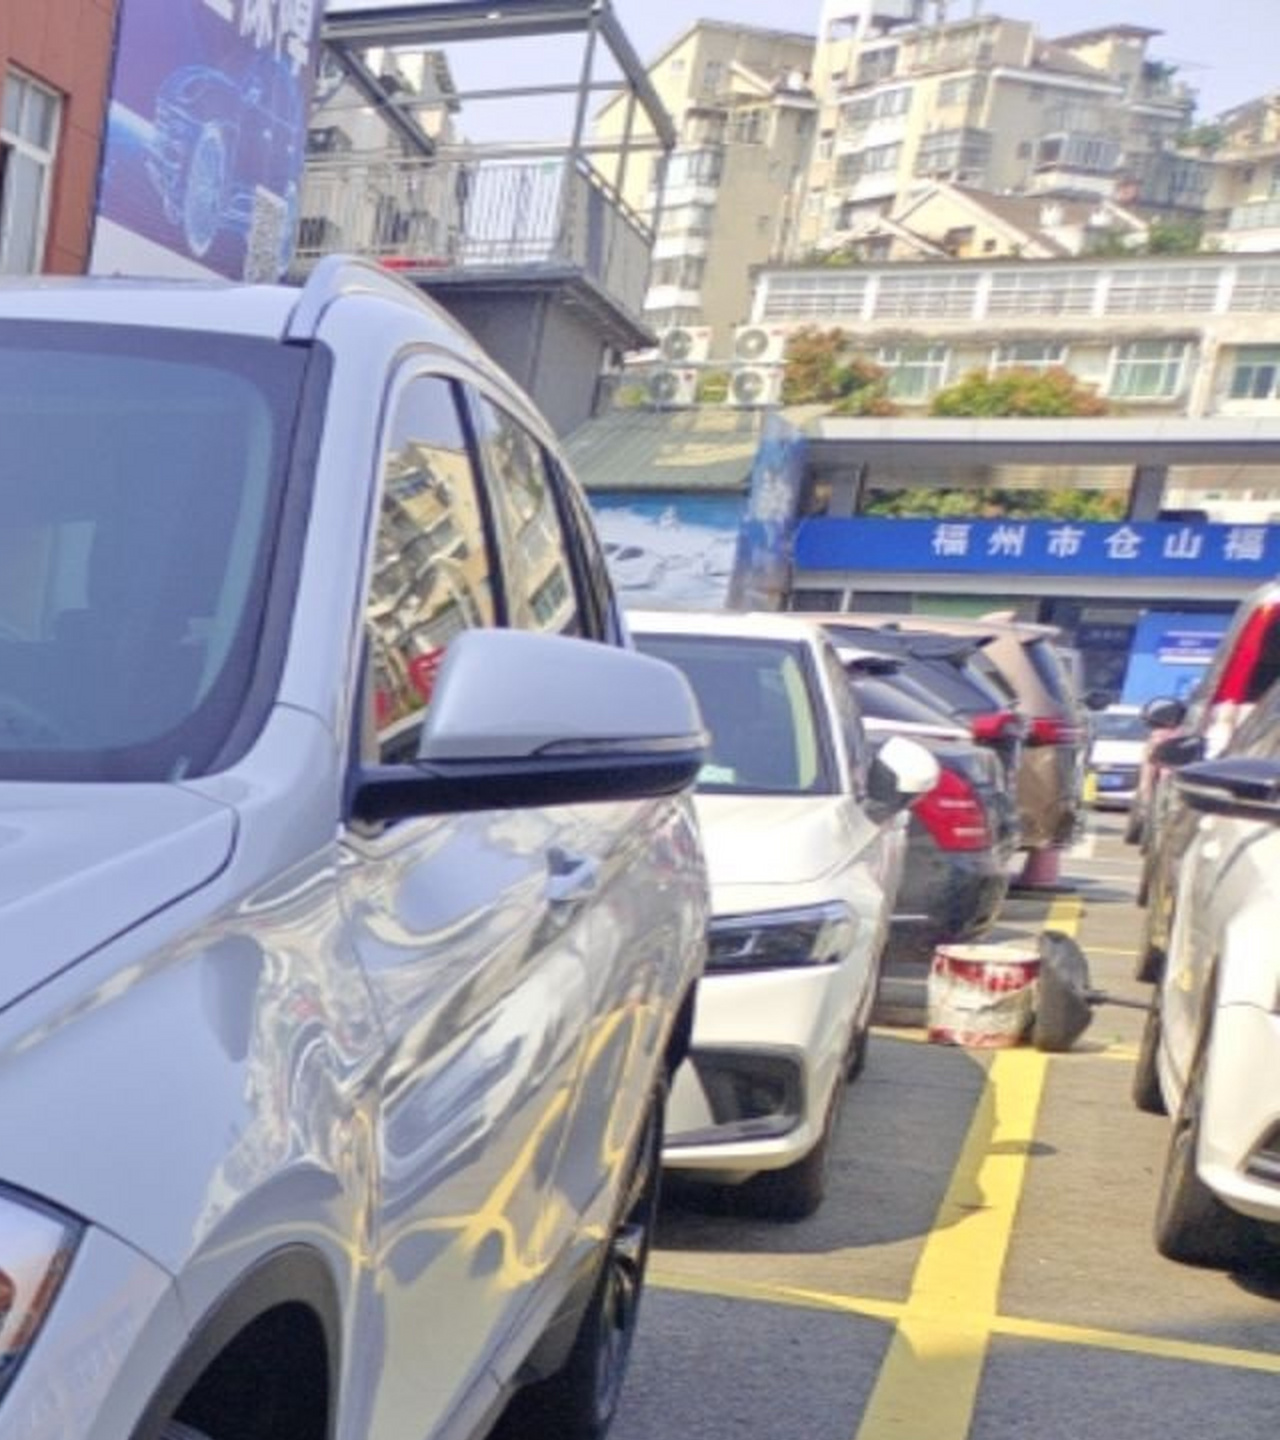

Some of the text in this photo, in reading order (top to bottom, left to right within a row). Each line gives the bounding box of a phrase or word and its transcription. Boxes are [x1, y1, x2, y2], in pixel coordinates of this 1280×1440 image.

[931, 523, 1267, 561] 福州市仓山福
